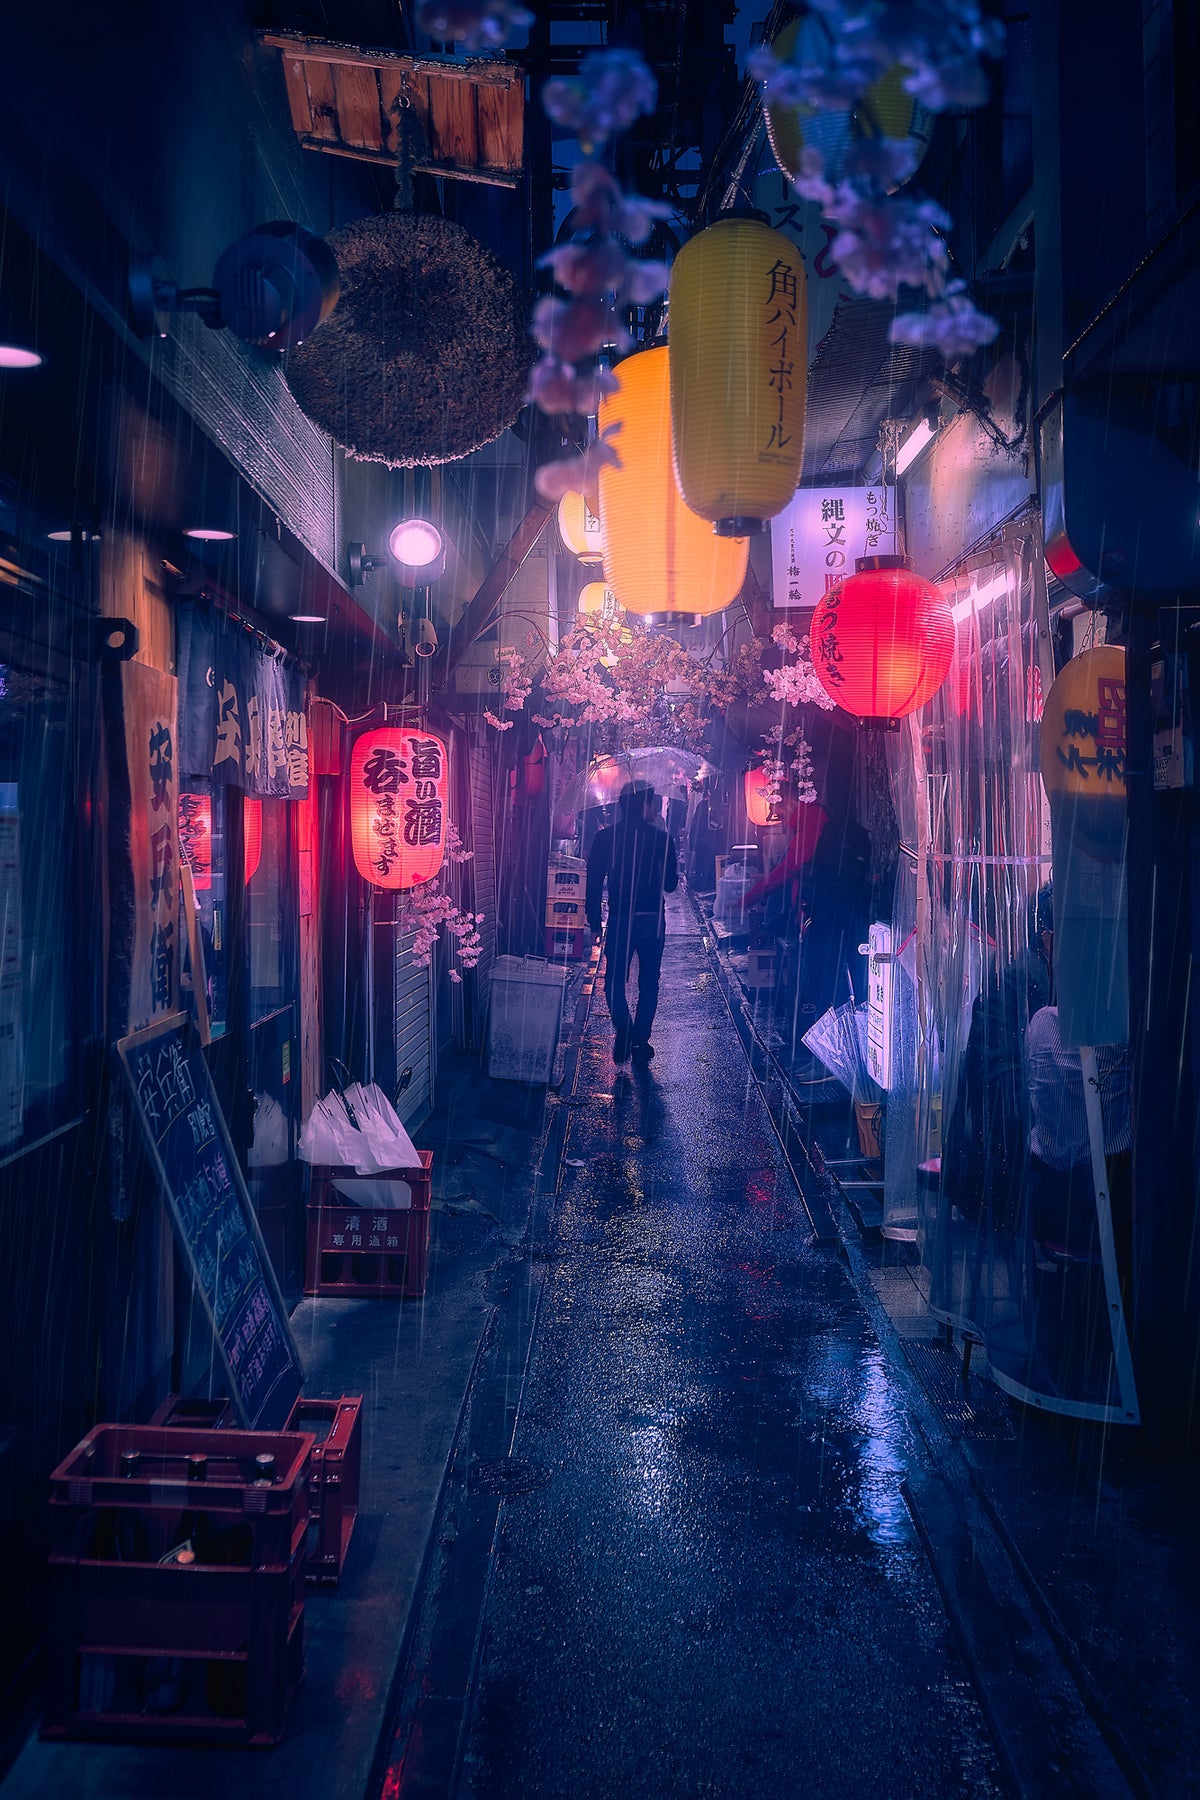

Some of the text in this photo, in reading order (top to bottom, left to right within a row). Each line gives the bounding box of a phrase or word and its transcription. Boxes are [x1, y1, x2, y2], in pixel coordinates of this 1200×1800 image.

[766, 259, 797, 450] 角ハイボール
[865, 491, 881, 547] もつ焼き
[787, 566, 802, 600] 梅一輪
[819, 584, 845, 688] もつ焼き
[363, 748, 409, 876] 呑ませます
[403, 738, 442, 847] 旨い酒
[149, 720, 173, 1011] 安兵衛
[137, 1039, 196, 1136] 安兵衛
[187, 1098, 216, 1145] 別館
[345, 1215, 388, 1231] 清酒
